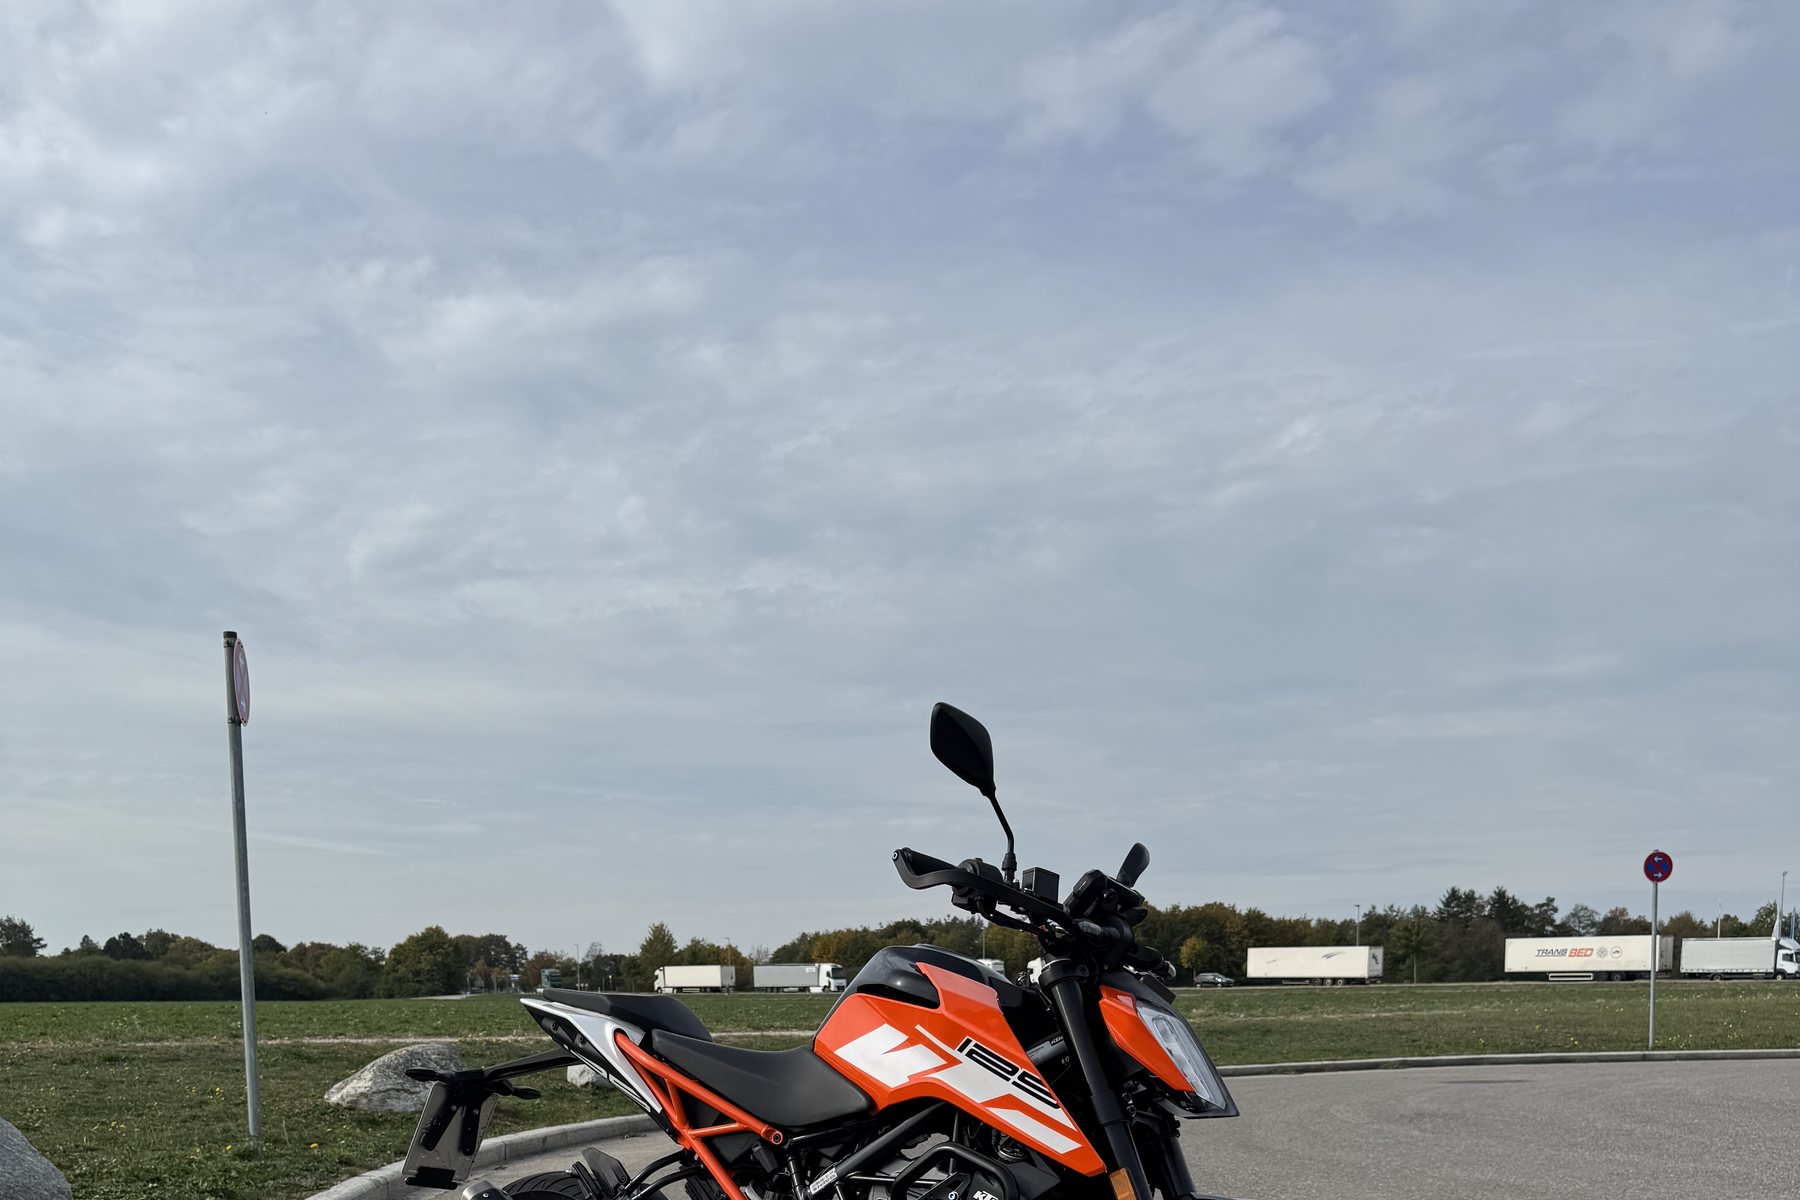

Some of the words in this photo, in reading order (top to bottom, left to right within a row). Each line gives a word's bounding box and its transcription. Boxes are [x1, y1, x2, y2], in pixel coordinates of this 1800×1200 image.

[1535, 948, 1567, 957] TRANS
[1568, 948, 1594, 957] BED
[956, 1037, 1062, 1110] 125
